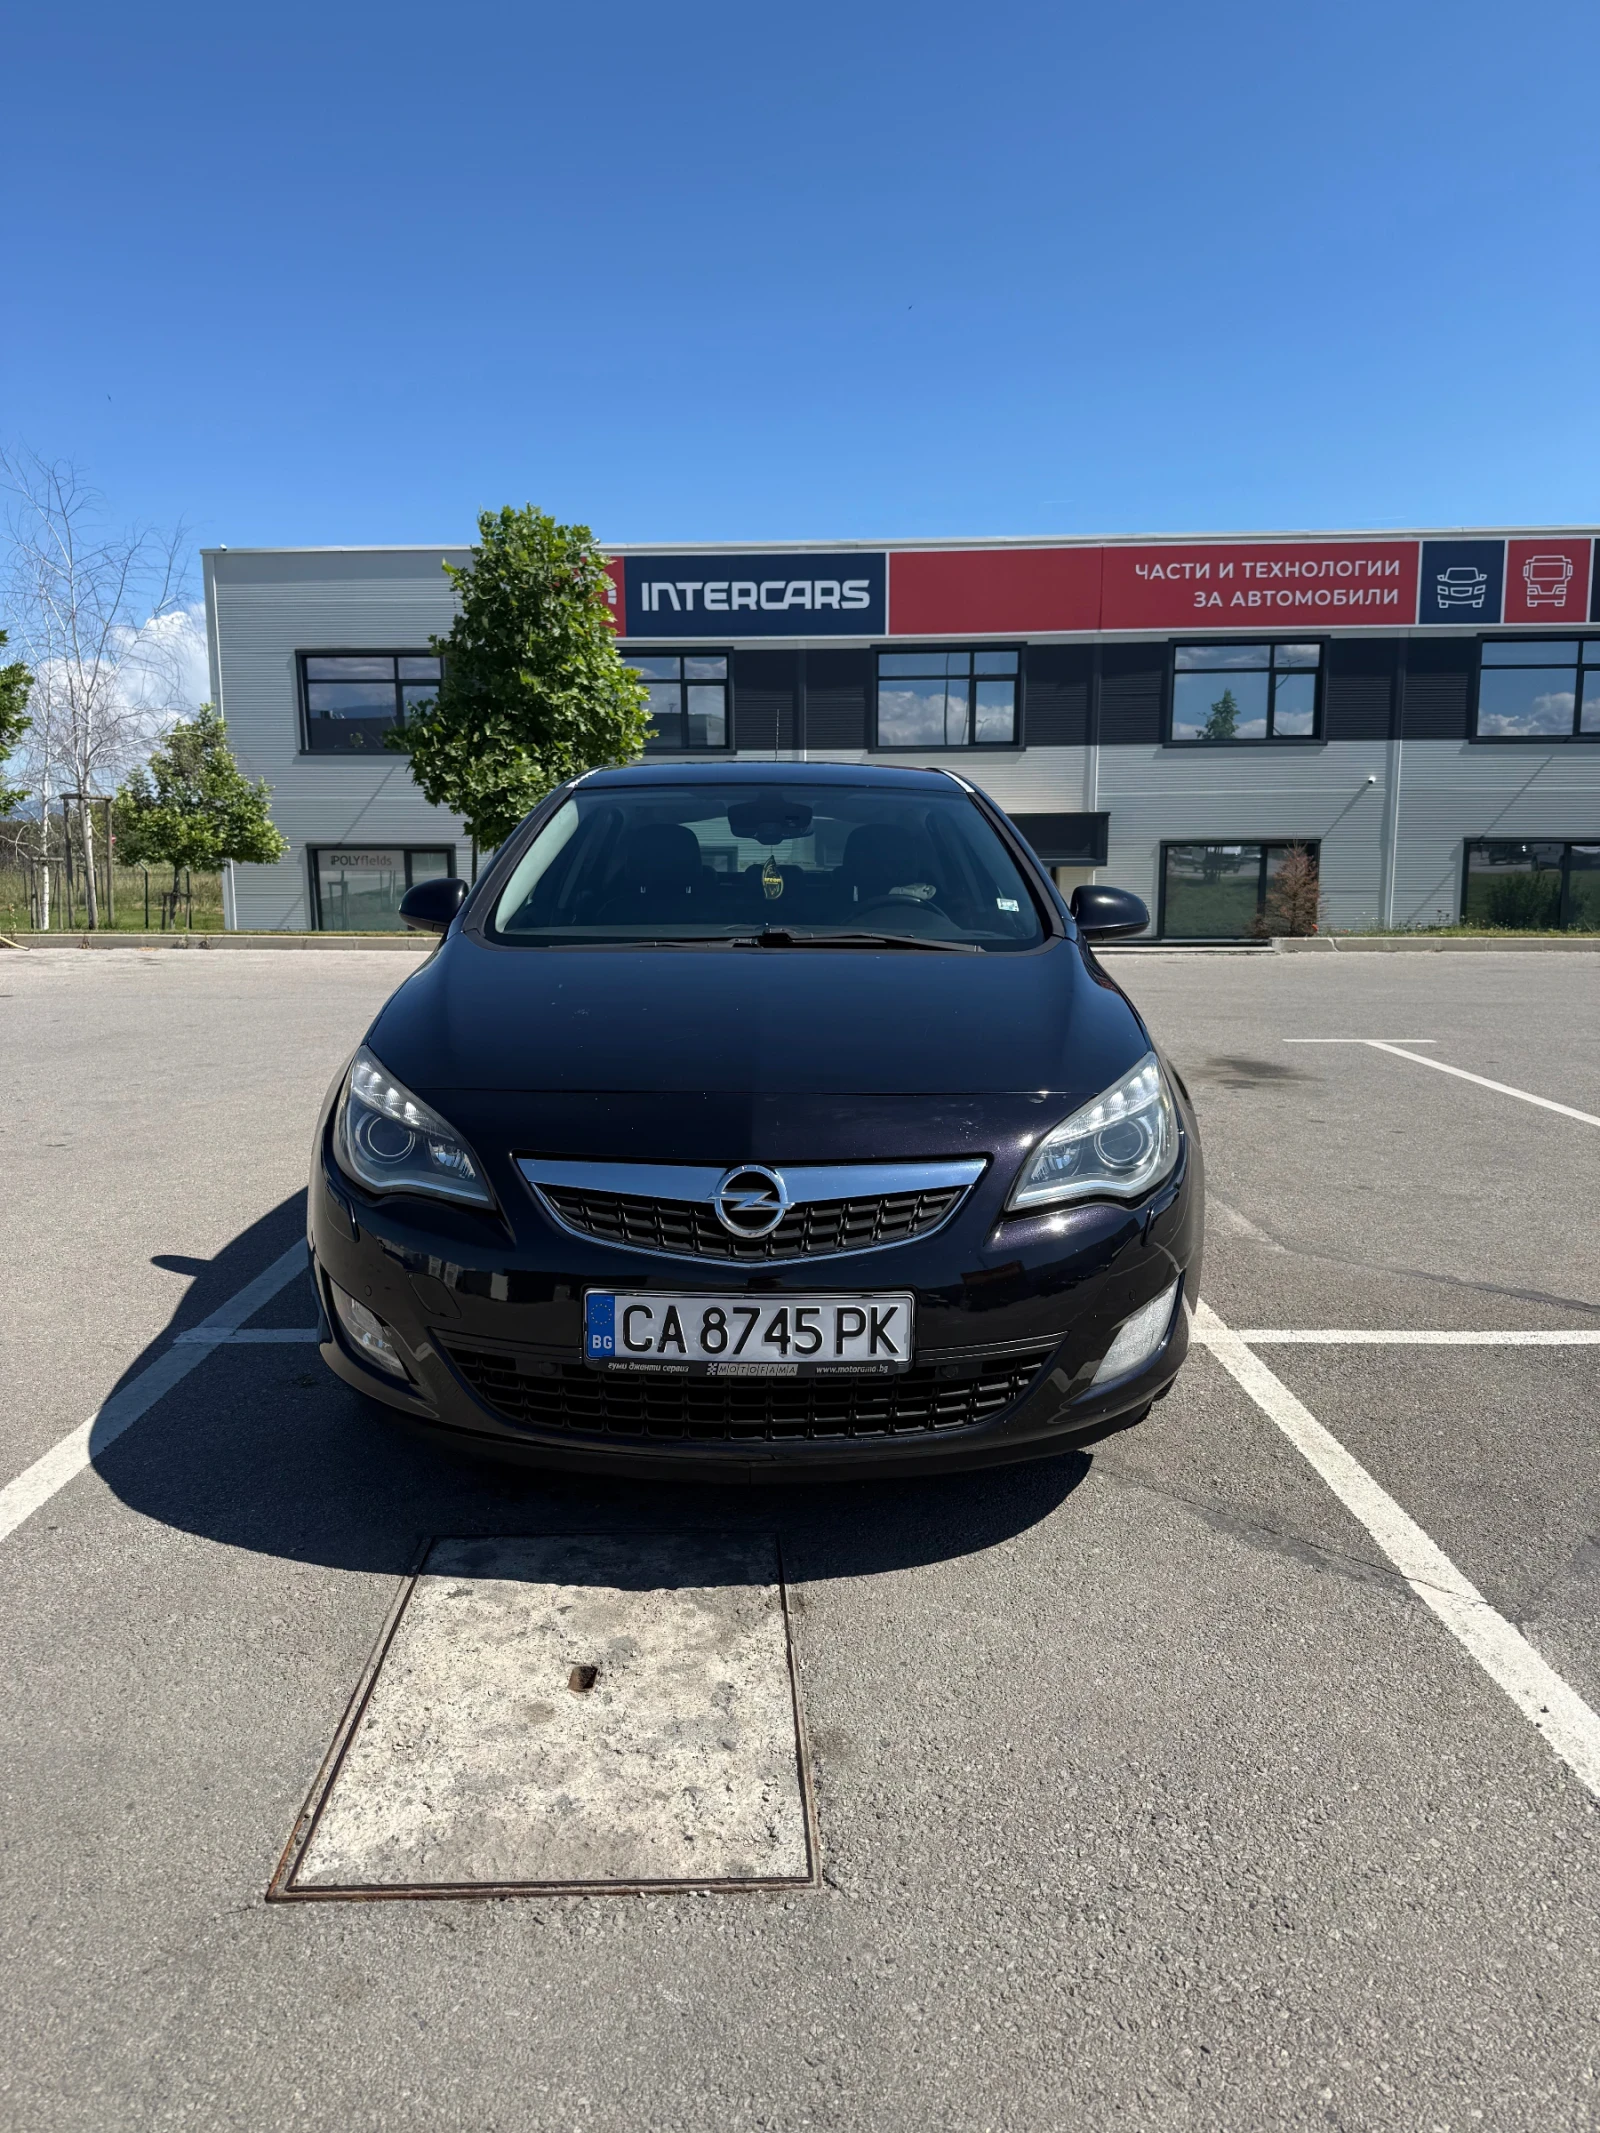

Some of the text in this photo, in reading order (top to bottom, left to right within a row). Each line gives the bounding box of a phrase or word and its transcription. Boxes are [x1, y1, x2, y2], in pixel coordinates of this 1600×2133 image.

[1135, 560, 1400, 580] ЧАСТИ И ТЕХНОЛОГИИ
[641, 580, 871, 611] INTERCARS
[1193, 588, 1399, 608] ЗА АВТОМОБИЛИ
[622, 1304, 900, 1355] CA 8745 PK
[592, 1335, 613, 1350] BG
